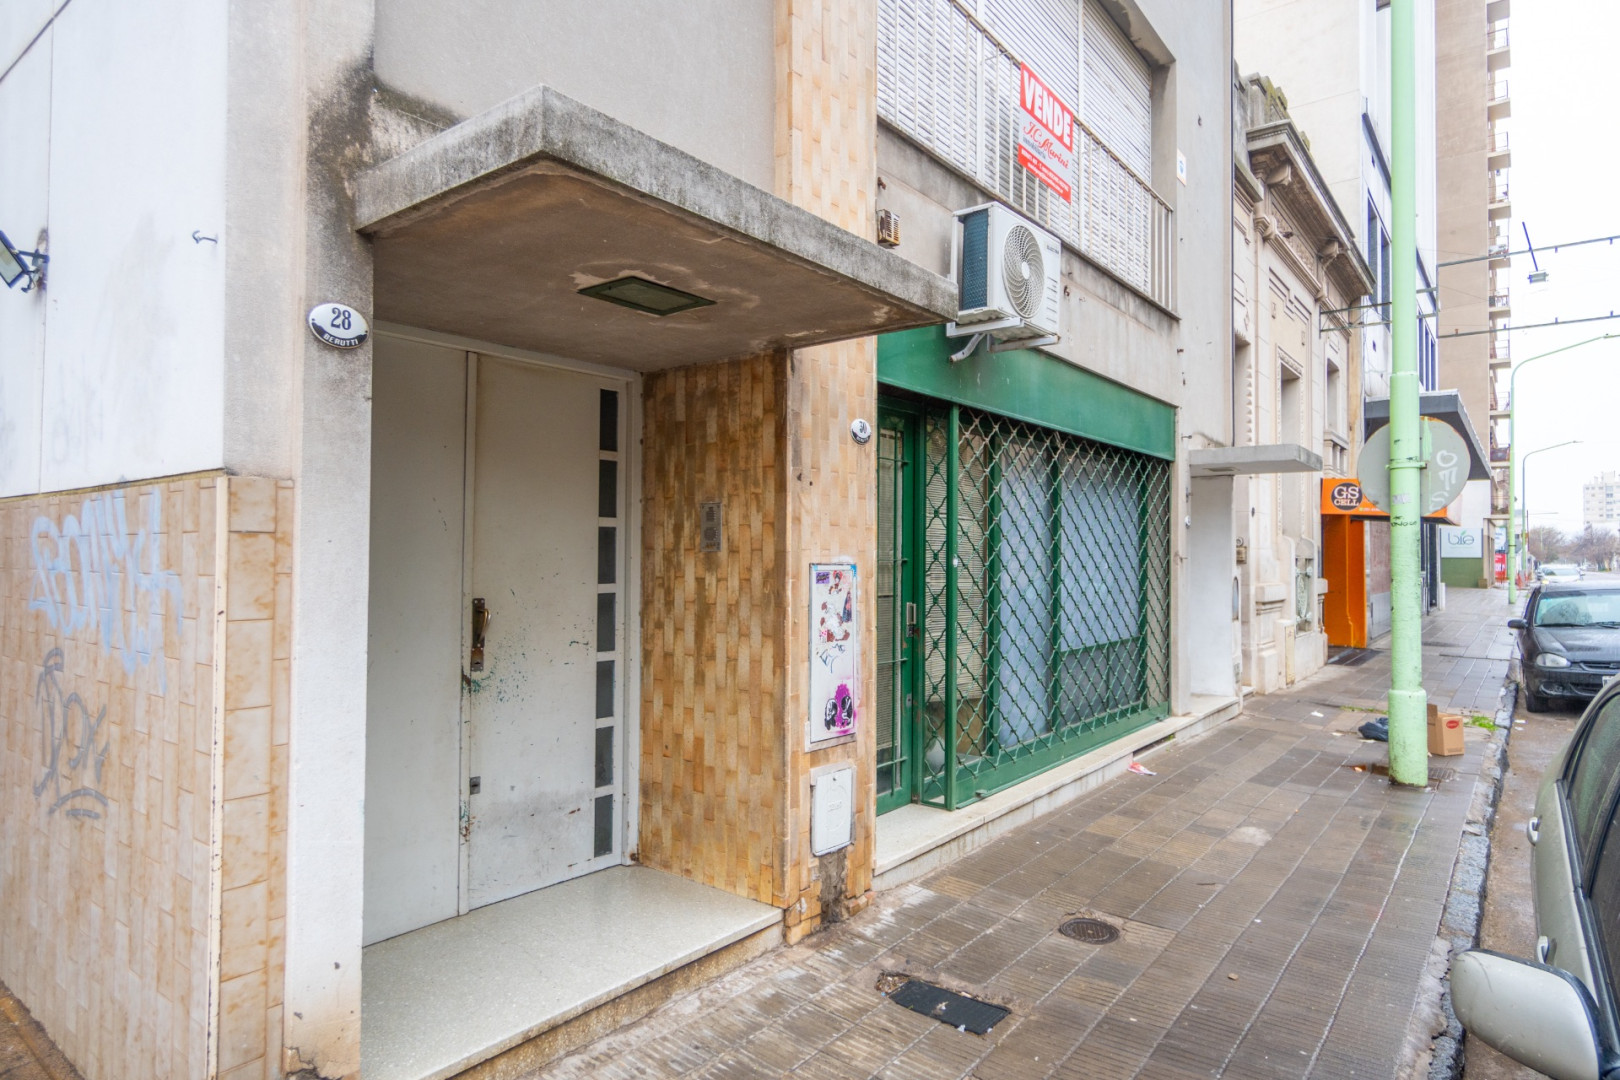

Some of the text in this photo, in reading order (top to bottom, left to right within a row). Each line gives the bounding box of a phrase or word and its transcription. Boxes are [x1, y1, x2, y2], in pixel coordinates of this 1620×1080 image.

[1023, 69, 1071, 148] VENDE
[330, 307, 351, 330] 28
[323, 333, 359, 346] BERUTTI
[1334, 486, 1359, 499] GS
[1333, 499, 1359, 507] CELL
